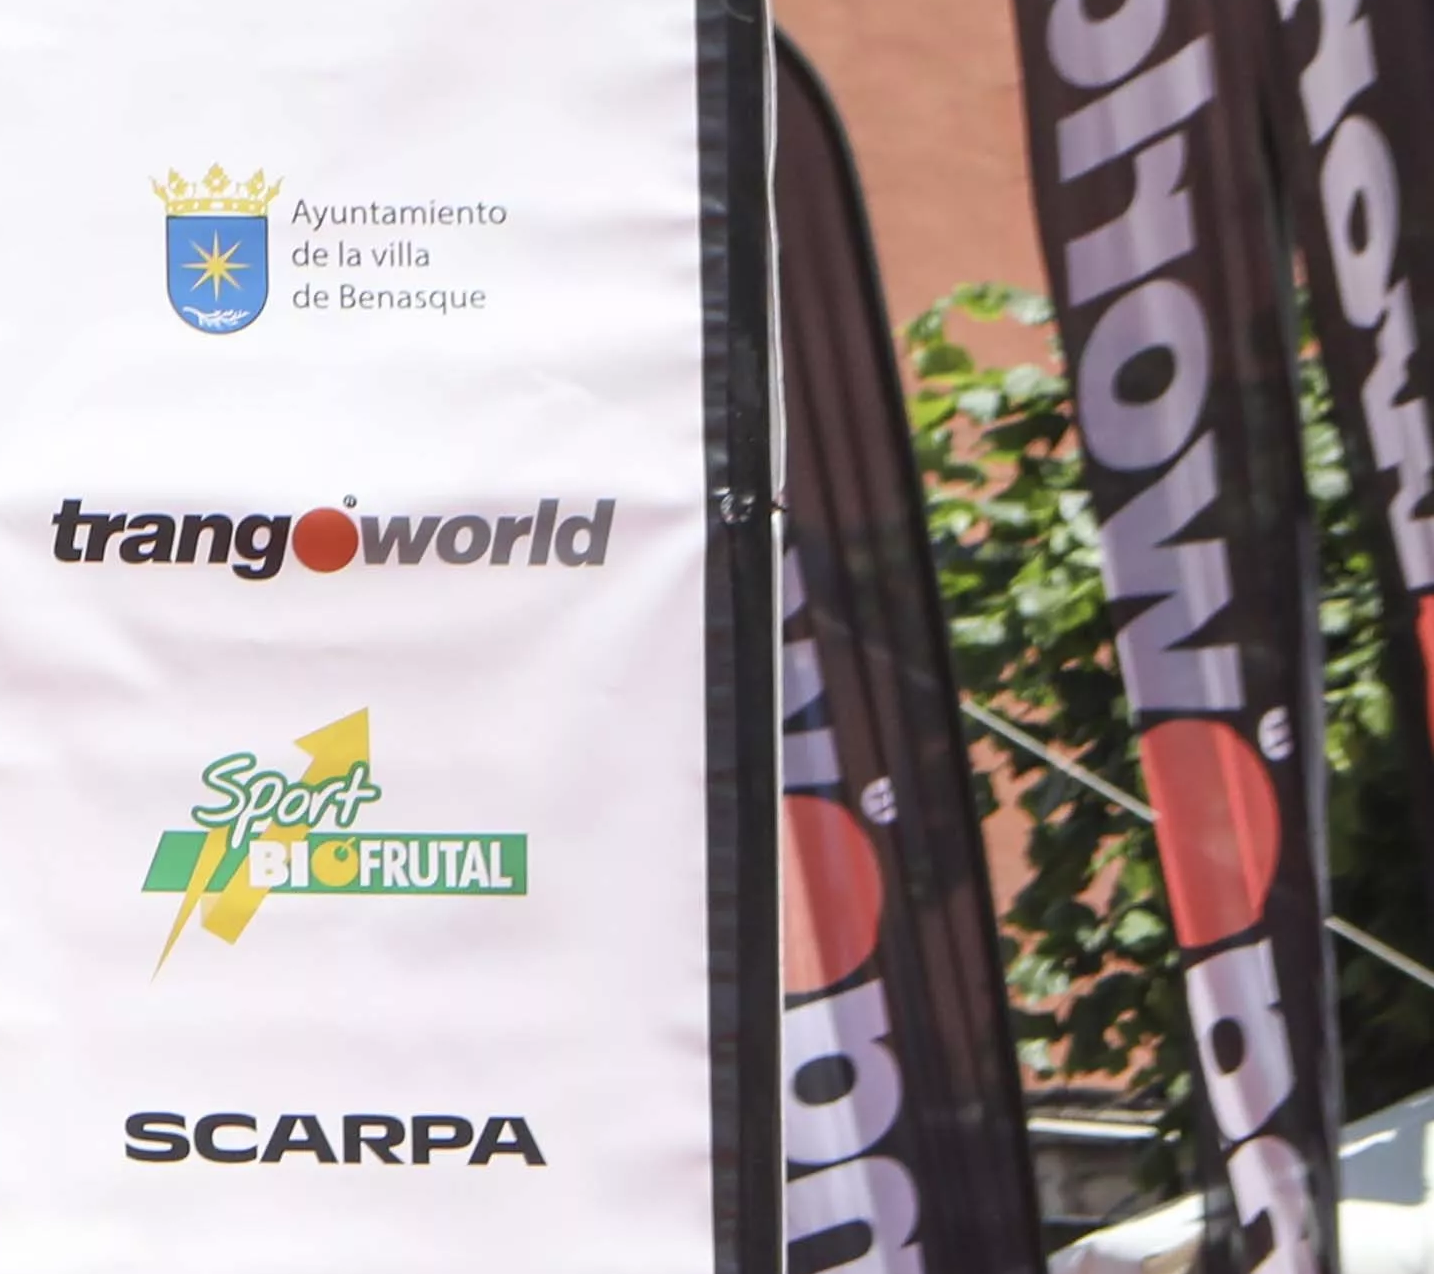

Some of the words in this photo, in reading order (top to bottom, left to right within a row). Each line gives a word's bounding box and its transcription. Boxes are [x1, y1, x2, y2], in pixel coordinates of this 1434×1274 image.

[290, 199, 507, 231] Ayuntamiento
[290, 242, 328, 268] de
[337, 242, 363, 268] la
[371, 242, 431, 268] villa
[291, 284, 329, 311] de
[339, 284, 488, 315] Benasque
[191, 752, 383, 847] Sport
[249, 837, 513, 888] BIOFRUTAL
[124, 1110, 548, 1166] SCARPA
